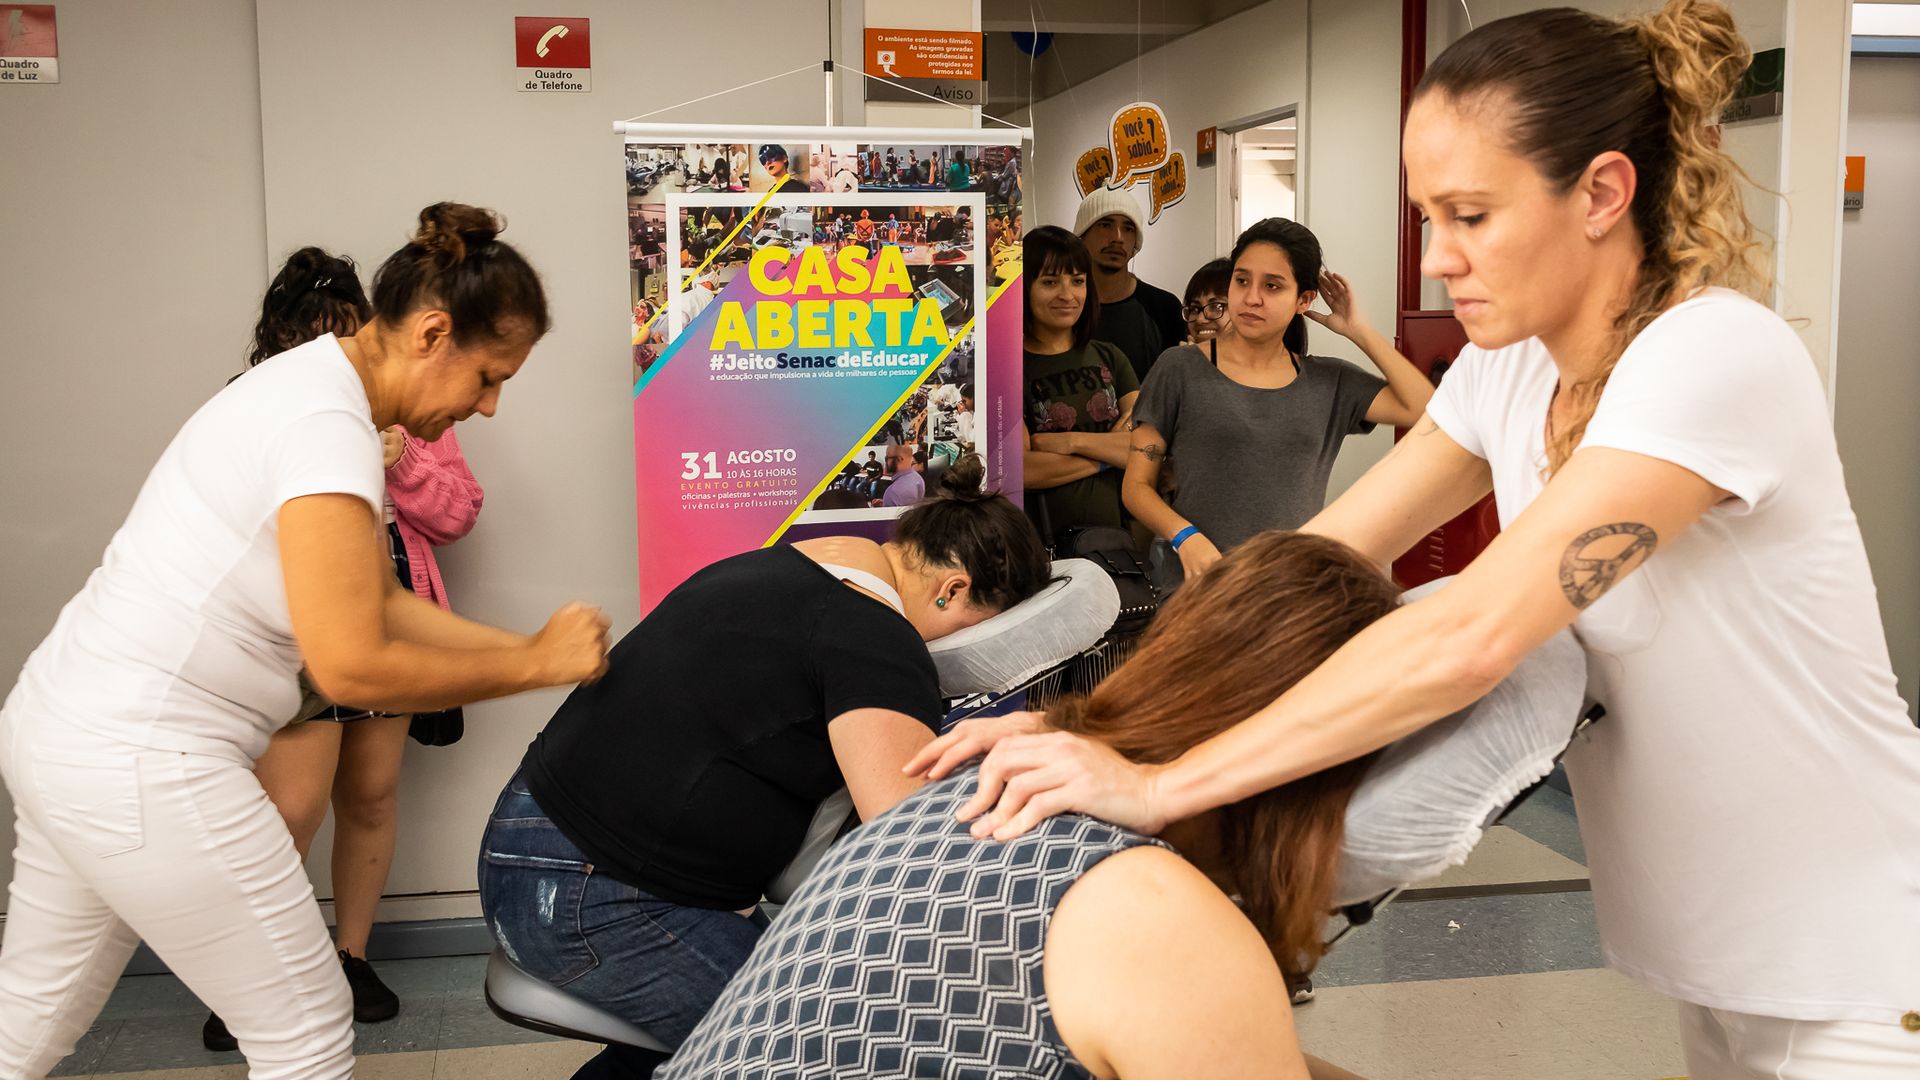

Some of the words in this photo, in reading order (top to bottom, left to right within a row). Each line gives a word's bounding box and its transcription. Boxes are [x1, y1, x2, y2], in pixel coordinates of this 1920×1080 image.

[949, 37, 974, 45] filmado.
[0, 59, 40, 69] Quadro
[1, 71, 15, 80] de
[18, 71, 38, 80] Luz
[535, 69, 573, 79] Quadro
[525, 80, 538, 89] de
[540, 81, 583, 90] Telefone
[933, 85, 974, 100] Aviso
[1123, 116, 1145, 138] você
[1205, 131, 1213, 149] 24
[1127, 138, 1153, 160] sabia
[748, 245, 914, 295] CASA
[709, 298, 951, 350] ABERTA
[710, 350, 929, 371] #JeitoSenacdeEducar
[716, 373, 752, 381] educação
[770, 371, 810, 380] impulsiona
[846, 369, 877, 377] milhares
[889, 369, 917, 377] pessoas
[681, 451, 722, 480] 31
[727, 449, 797, 464] AGOSTO
[727, 471, 737, 479] 10
[753, 470, 763, 478] 16
[766, 468, 797, 477] HORAS
[681, 482, 729, 490] EVENTO
[737, 479, 797, 489] GRATUITO
[718, 490, 751, 500] palestras
[758, 488, 798, 498] workshops
[682, 500, 730, 510] vivências
[734, 499, 798, 509] profissionais
